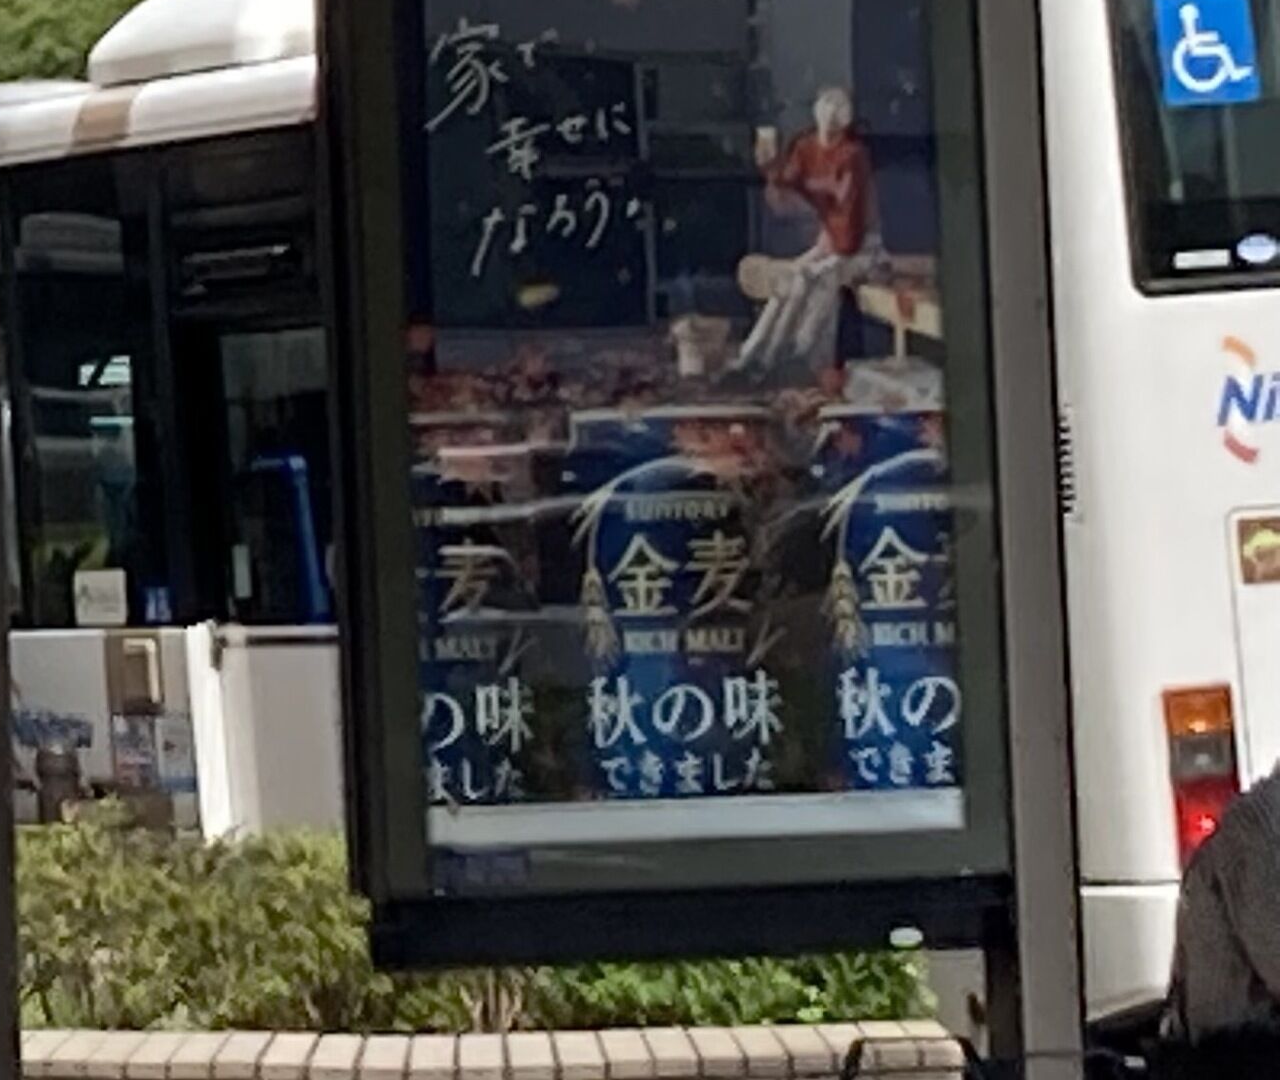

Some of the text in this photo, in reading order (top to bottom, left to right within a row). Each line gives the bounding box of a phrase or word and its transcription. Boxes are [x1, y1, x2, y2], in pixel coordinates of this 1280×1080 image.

[424, 16, 559, 132] 家で
[485, 101, 632, 181] 幸せに
[415, 536, 504, 624] 麦
[607, 528, 754, 619] 金麦
[857, 525, 955, 611] 金
[684, 627, 745, 652] MALT
[421, 676, 536, 754] の味
[587, 669, 785, 749] 秋の味
[836, 666, 963, 741] 秋の
[599, 747, 777, 796] できました
[849, 740, 956, 785] できま
